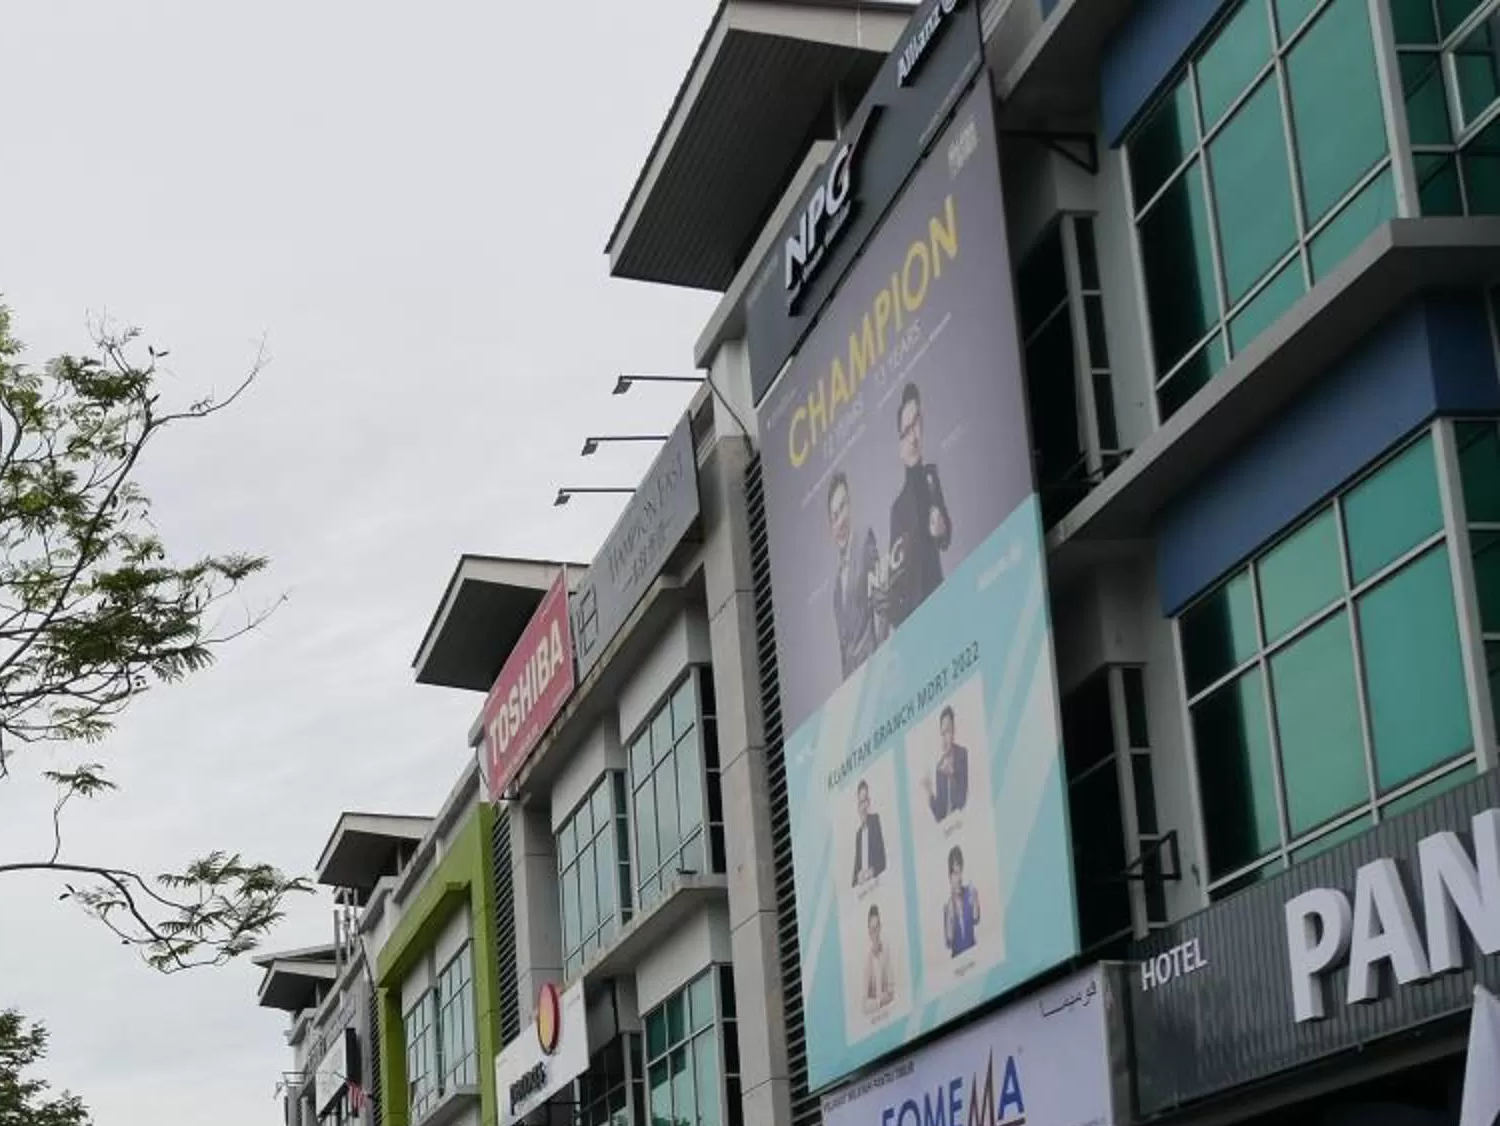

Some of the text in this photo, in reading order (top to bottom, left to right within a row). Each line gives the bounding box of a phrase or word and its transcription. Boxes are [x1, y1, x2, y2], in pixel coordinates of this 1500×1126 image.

[785, 144, 850, 290] NPG
[789, 194, 958, 468] CHAMPION
[489, 618, 565, 765] TOSHIBA
[873, 703, 916, 748] BRANCH
[916, 667, 949, 712] MDRT
[951, 639, 981, 679] 2022
[1141, 937, 1208, 992] HOTEL
